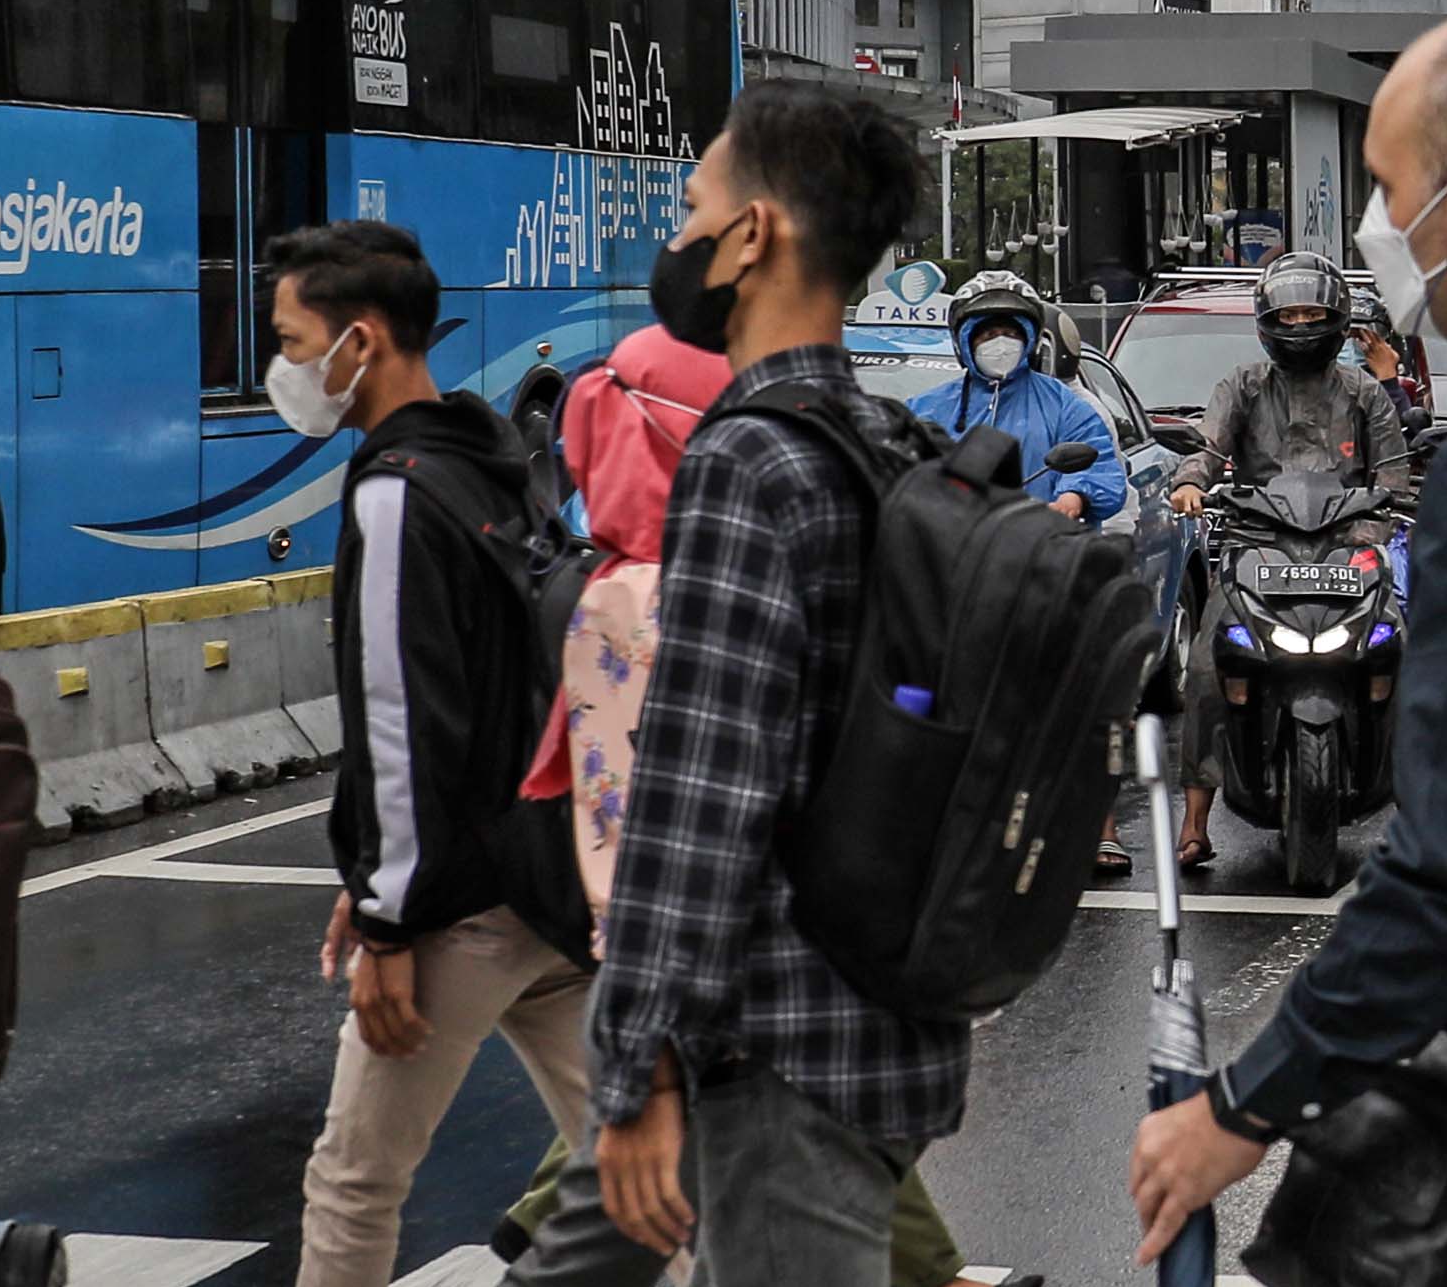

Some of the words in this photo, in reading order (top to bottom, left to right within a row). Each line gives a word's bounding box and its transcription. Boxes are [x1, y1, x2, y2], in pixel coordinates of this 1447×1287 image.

[351, 3, 378, 32] AYO
[379, 9, 407, 59] BUS
[352, 32, 379, 55] NAIK
[874, 306, 947, 321] TAKSI
[1260, 566, 1270, 580] B
[1279, 567, 1320, 580] 4650
[1328, 567, 1358, 582] SDL
